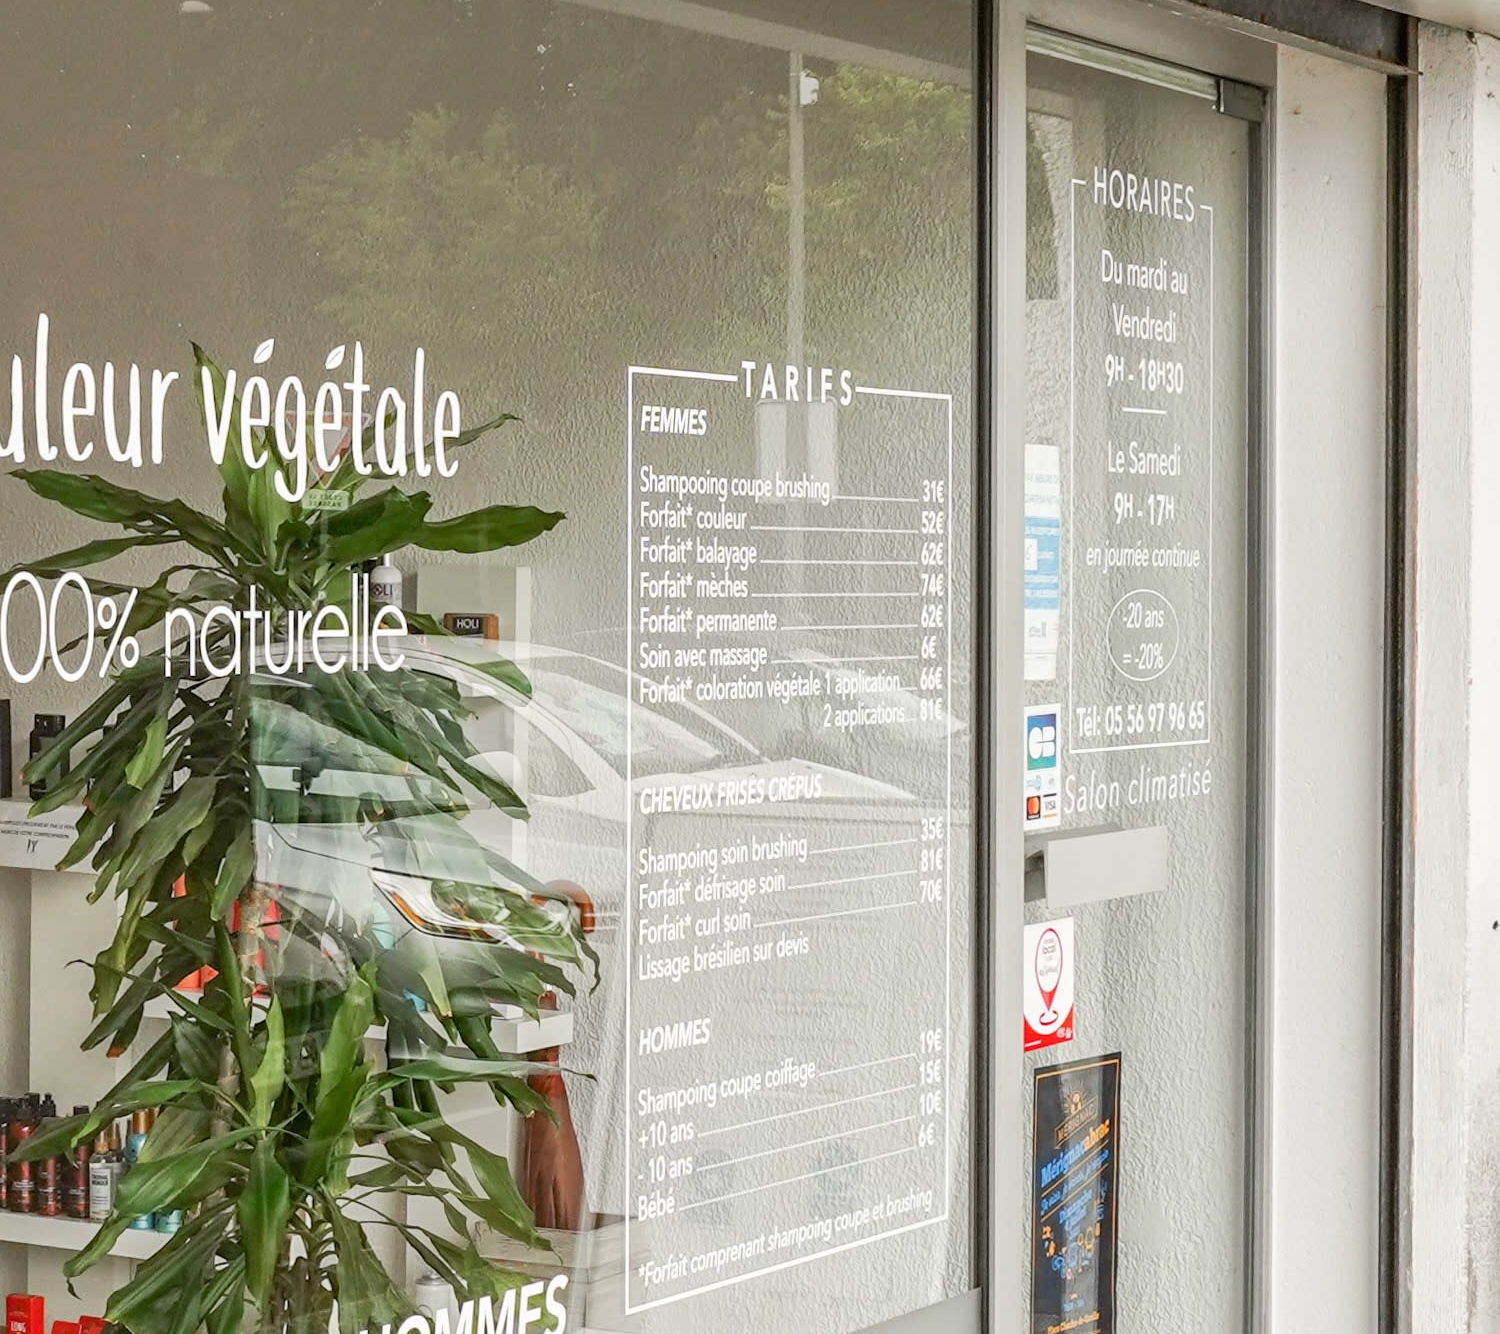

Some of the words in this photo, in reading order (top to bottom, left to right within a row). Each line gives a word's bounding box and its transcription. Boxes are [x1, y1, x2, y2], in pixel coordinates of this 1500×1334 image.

[1094, 166, 1194, 222] HORAIRES
[1101, 250, 1122, 284] Du
[1127, 258, 1167, 291] mardi
[1171, 271, 1187, 294] au
[1113, 303, 1176, 343] Vendredi
[742, 361, 852, 406] TARIFS
[1105, 354, 1123, 386] 9H
[1139, 358, 1184, 394] 18H30
[201, 338, 461, 502] végétale
[641, 405, 707, 435] FEMMES
[1108, 440, 1124, 473] Le
[1129, 441, 1181, 476] Samedi
[640, 465, 728, 501] Shampooing
[731, 478, 771, 503] coupe
[776, 472, 830, 506] brushing
[923, 480, 944, 503] 31€
[697, 505, 746, 530] couleur
[922, 512, 944, 534] 52€
[1114, 492, 1133, 524] 9H
[1148, 494, 1174, 526] 17H
[697, 539, 757, 569] balayage
[921, 543, 944, 565] 62€
[1086, 547, 1101, 566] en
[1103, 540, 1148, 573] journée
[1152, 543, 1200, 567] continue
[697, 572, 748, 598] mèches
[921, 574, 944, 596] 74€
[164, 572, 410, 676] naturelle
[457, 618, 479, 629] HOLI
[697, 610, 777, 638] permanente
[921, 604, 943, 627] 62€
[1123, 602, 1142, 628] -20
[1145, 610, 1164, 627] ans
[640, 643, 670, 669] Soin
[675, 649, 706, 666] avec
[710, 646, 767, 671] massage
[922, 636, 936, 658] 6€
[1135, 643, 1163, 669] -20%
[697, 674, 763, 701] coloration
[767, 671, 821, 703] végétale
[825, 674, 830, 694] 1
[835, 670, 899, 699] application
[921, 667, 943, 690] 66€
[824, 704, 831, 727] 2
[835, 703, 905, 732] applications
[920, 698, 942, 721] 81€
[1076, 705, 1100, 737] Tél:
[1105, 706, 1122, 735] 05
[1127, 705, 1144, 734] 56
[1148, 703, 1164, 731] 97
[1169, 702, 1185, 731] 96
[1189, 701, 1204, 729] 65
[640, 786, 713, 814] CHEVEUX
[718, 772, 764, 807] FRISÉS
[769, 773, 822, 803] CRÉPUS
[1064, 771, 1119, 813] Salon
[1129, 759, 1211, 805] climatisé
[639, 843, 718, 875] Shampoing
[722, 839, 748, 863] soin
[752, 833, 807, 862] brushing
[921, 817, 943, 841] 35€
[695, 871, 756, 903] défrisage
[760, 869, 785, 895] soin
[921, 848, 943, 871] 81€
[695, 907, 720, 936] curl
[724, 906, 751, 932] soin
[919, 880, 942, 903] 70€
[639, 953, 689, 982] Lissage
[694, 940, 749, 971] brésilien
[754, 941, 772, 962] sur
[776, 932, 809, 958] devis
[639, 1018, 710, 1055] HOMMES
[639, 1077, 716, 1116] Shampoing
[721, 1072, 761, 1102] coupe
[765, 1057, 815, 1089] coiffage
[919, 1028, 941, 1054] 19€
[670, 1119, 694, 1143] ans
[919, 1060, 941, 1085] 15€
[669, 1155, 693, 1177] ans
[919, 1091, 941, 1116] 10€
[639, 1186, 674, 1221] Bébé
[919, 1122, 934, 1147] 6€
[691, 1236, 764, 1274] comprenant
[768, 1216, 831, 1252] shampoing
[835, 1204, 869, 1233] coupe
[873, 1199, 884, 1221] et
[887, 1188, 932, 1215] brushing
